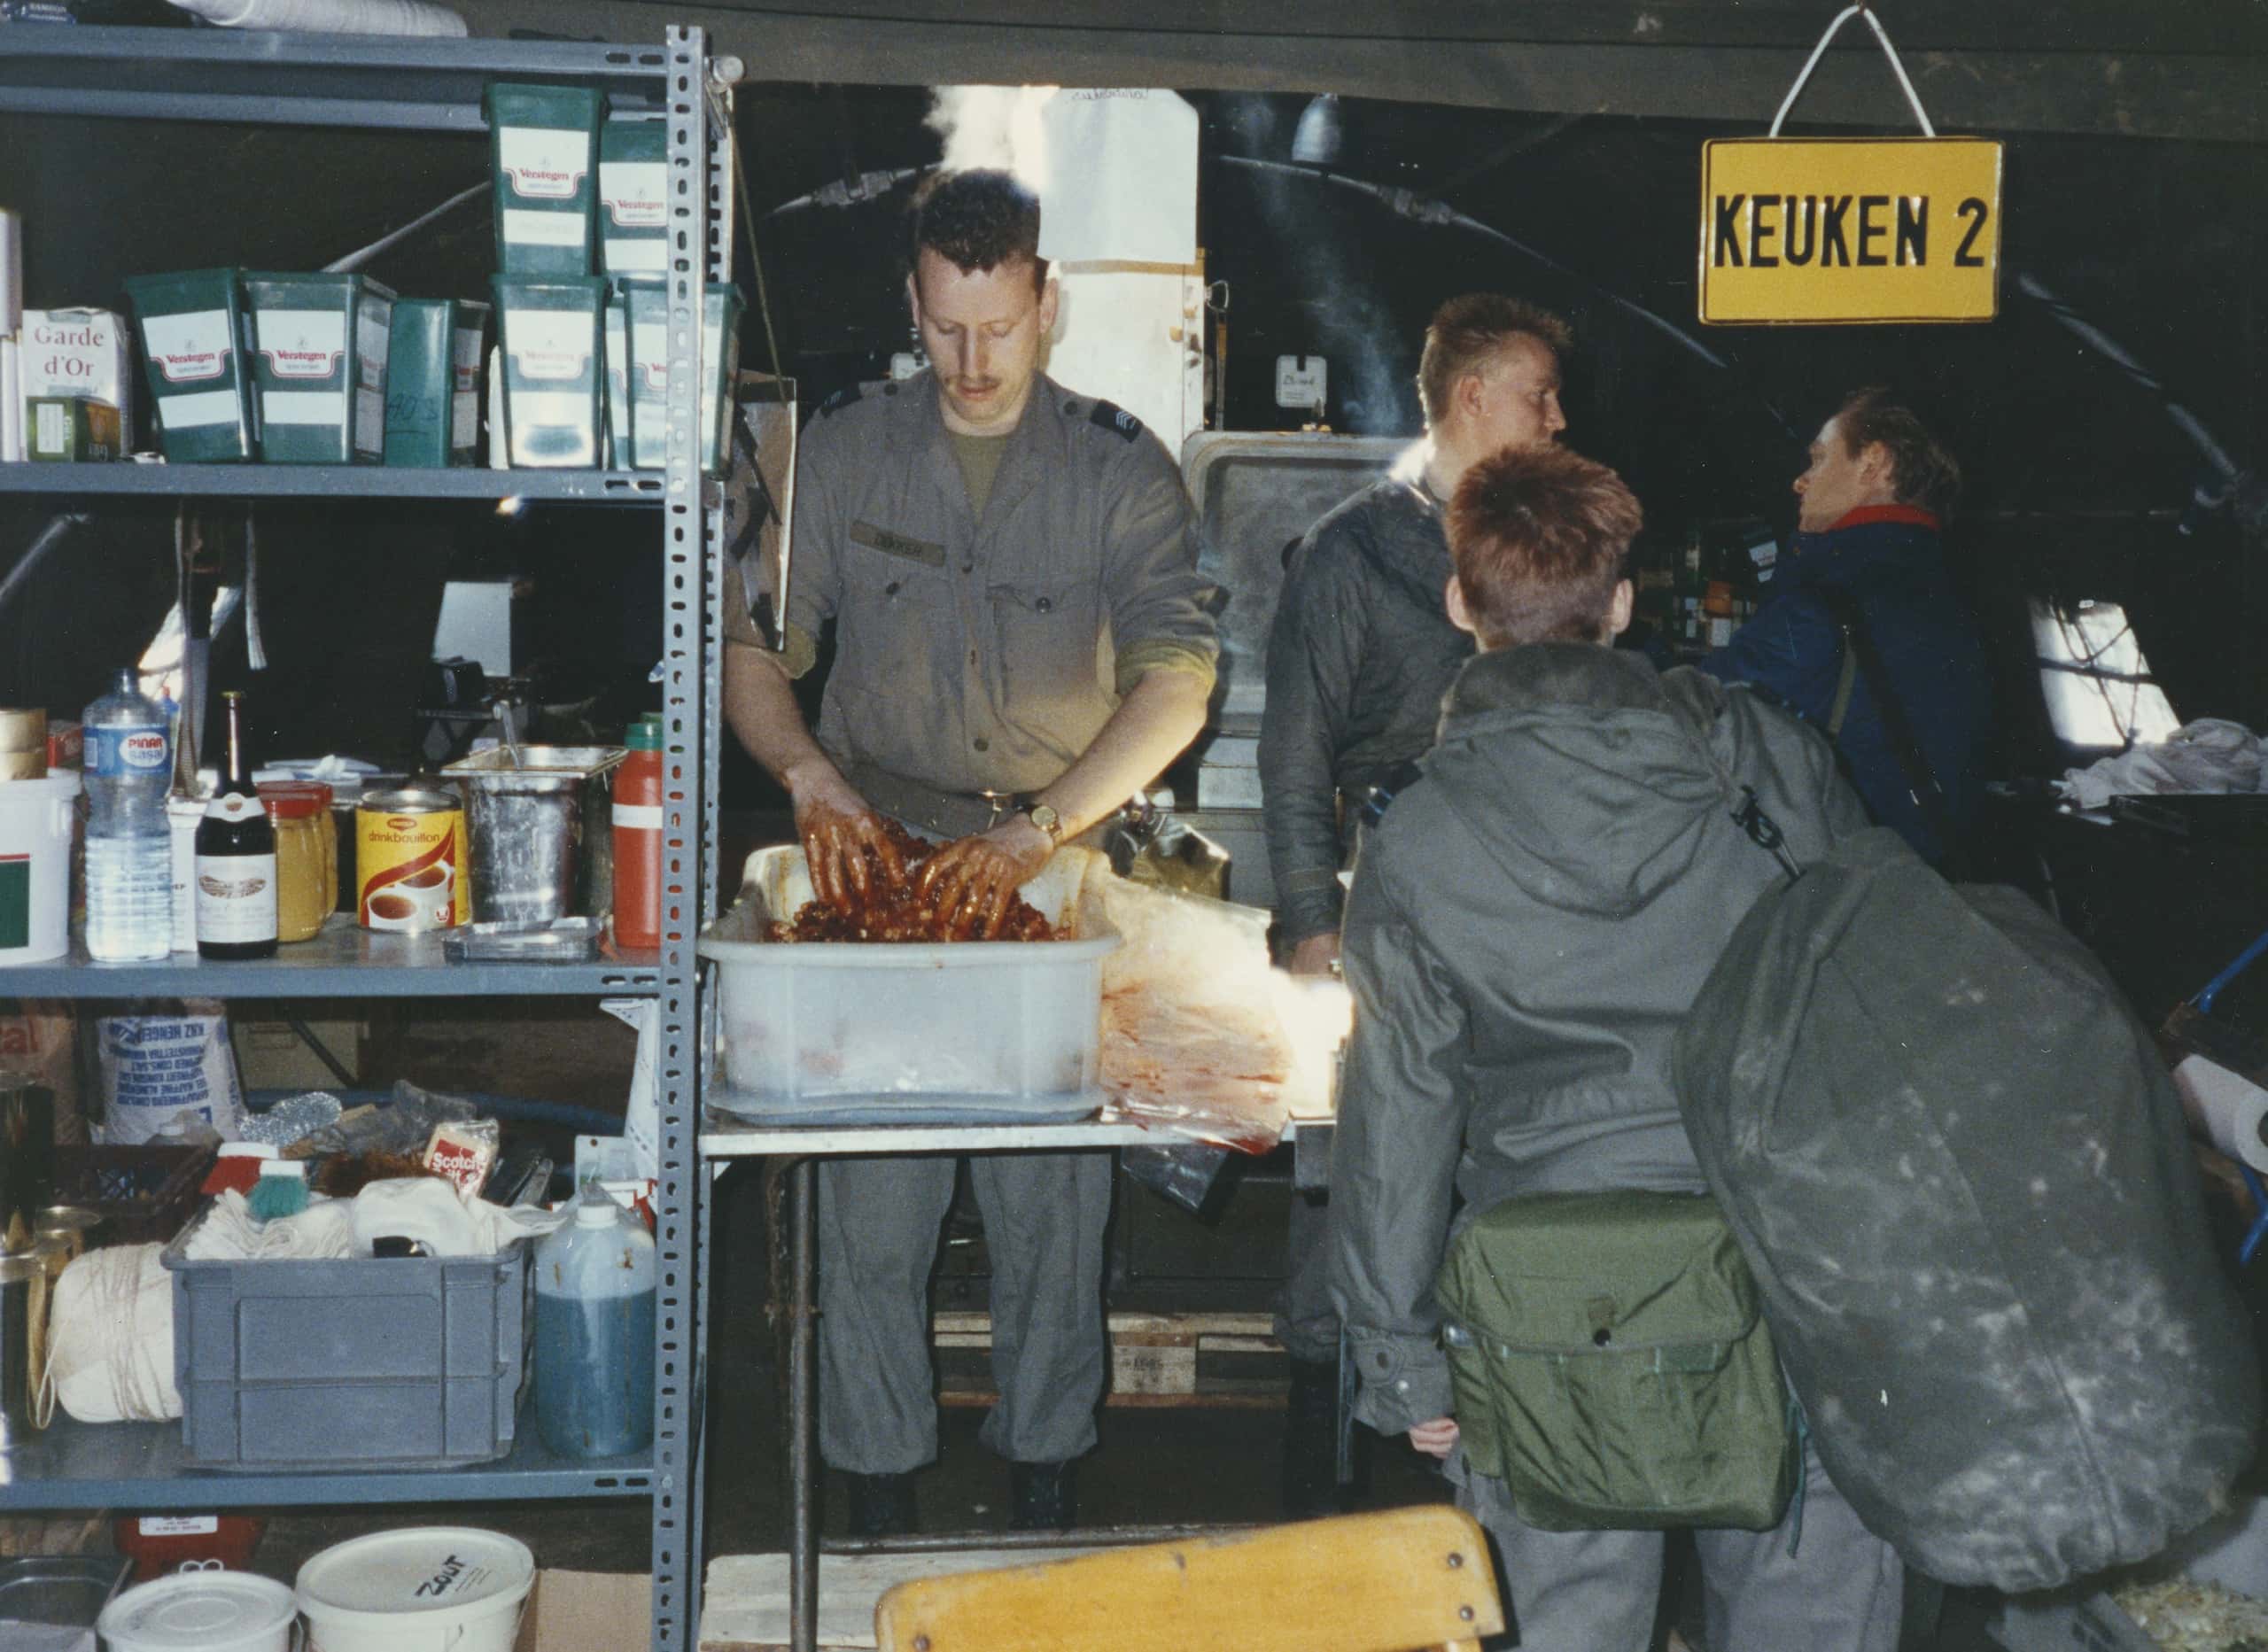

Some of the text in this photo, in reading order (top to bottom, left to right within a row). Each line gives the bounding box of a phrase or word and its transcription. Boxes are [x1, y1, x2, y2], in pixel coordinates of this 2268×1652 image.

[519, 168, 570, 181] Verstegen
[618, 199, 664, 210] Verstegen
[1713, 194, 1988, 268] KEUKEN 2
[35, 326, 105, 346] Garde
[166, 352, 215, 364] Verstegen
[276, 350, 326, 361] Verstegen
[44, 355, 94, 376] d'Or
[369, 831, 440, 843] drinkbouillon
[414, 1555, 466, 1597] ZOUT
